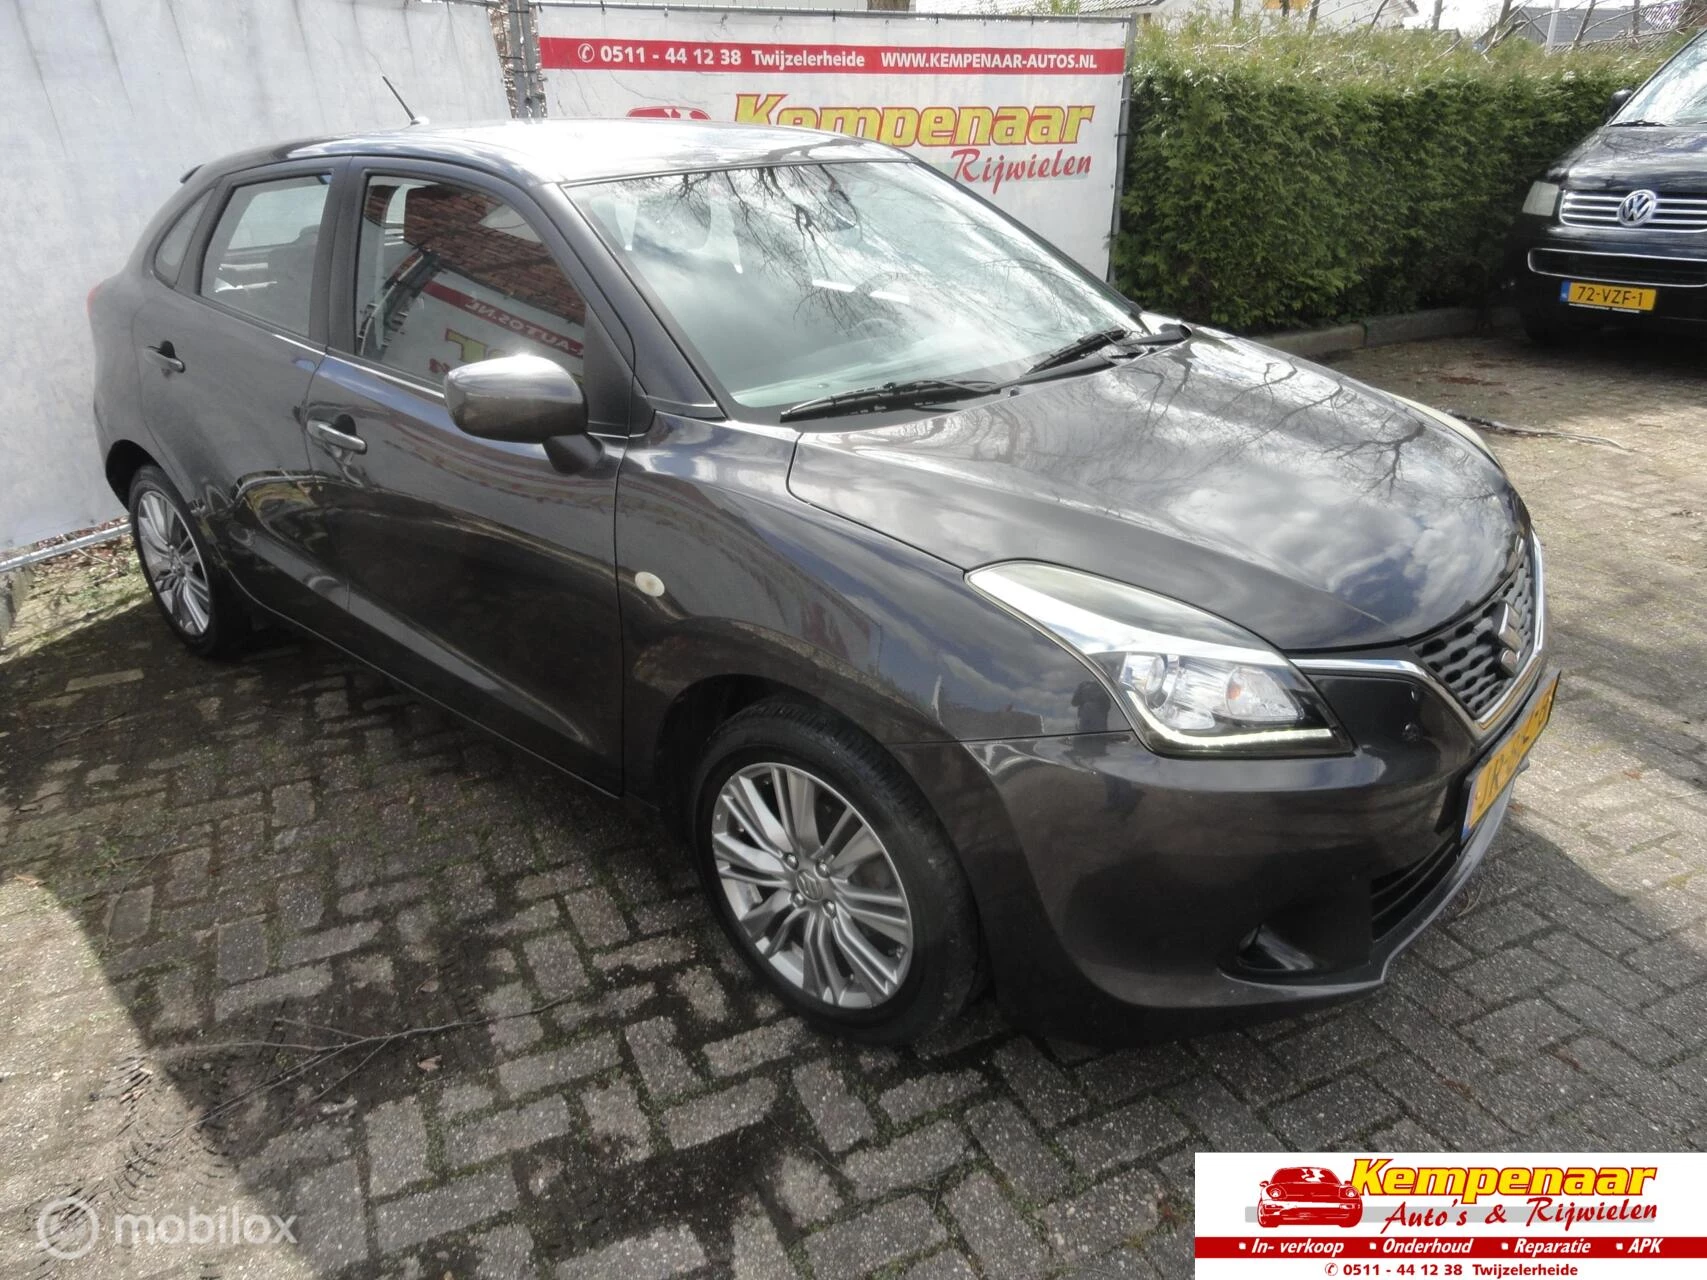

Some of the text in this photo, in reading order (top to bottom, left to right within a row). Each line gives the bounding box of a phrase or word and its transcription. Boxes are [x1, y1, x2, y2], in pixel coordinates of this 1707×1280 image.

[600, 45, 645, 63] 0511
[665, 47, 687, 64] 44
[694, 48, 714, 65] 12
[720, 49, 742, 65] 38
[751, 49, 865, 71] Twijzelerheide
[880, 51, 1098, 69] WWW.KEMPENAAR-AUTOS.NL
[950, 149, 1092, 195] Rijwielen
[1577, 285, 1644, 307] 72-VZF-1
